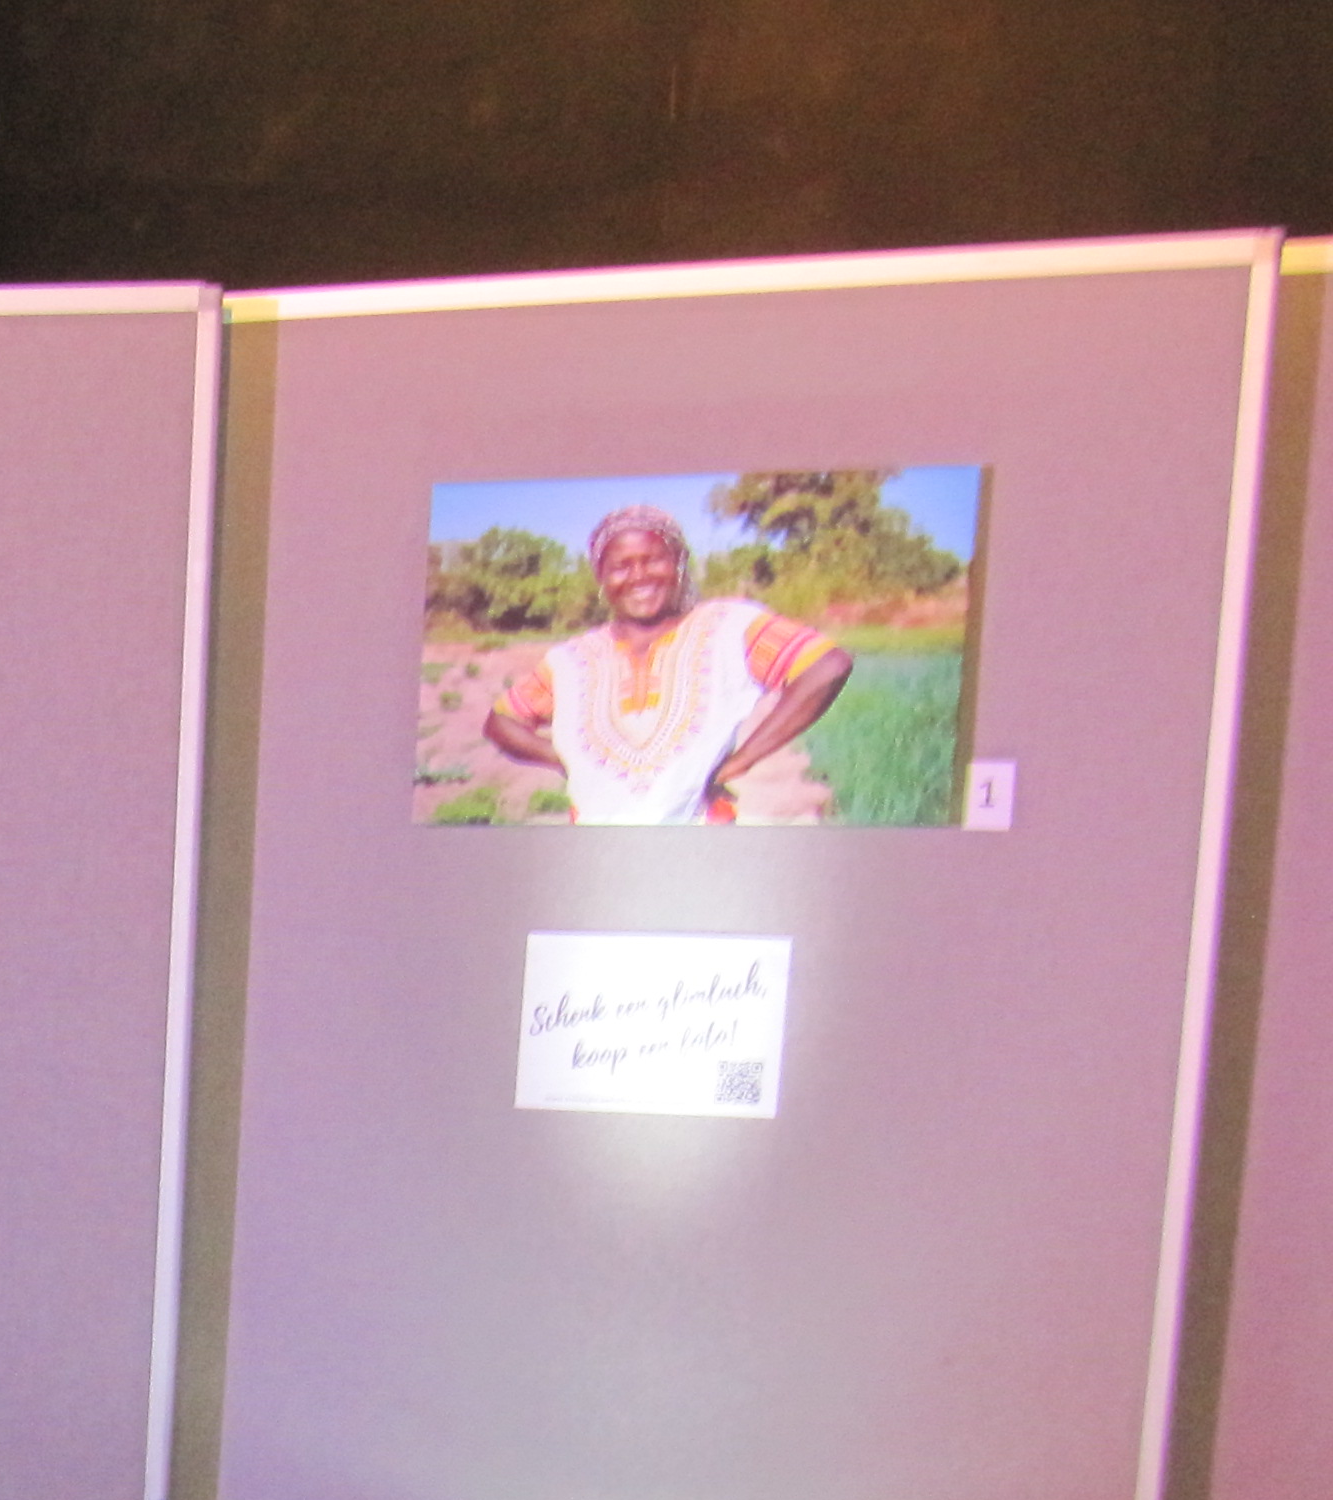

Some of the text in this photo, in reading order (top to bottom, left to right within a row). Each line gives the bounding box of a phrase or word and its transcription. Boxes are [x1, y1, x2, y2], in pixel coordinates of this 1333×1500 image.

[978, 781, 995, 808] 1
[529, 992, 607, 1036] Schenk
[616, 1000, 648, 1018] een
[571, 1039, 628, 1075] koop
[638, 1041, 669, 1057] een
